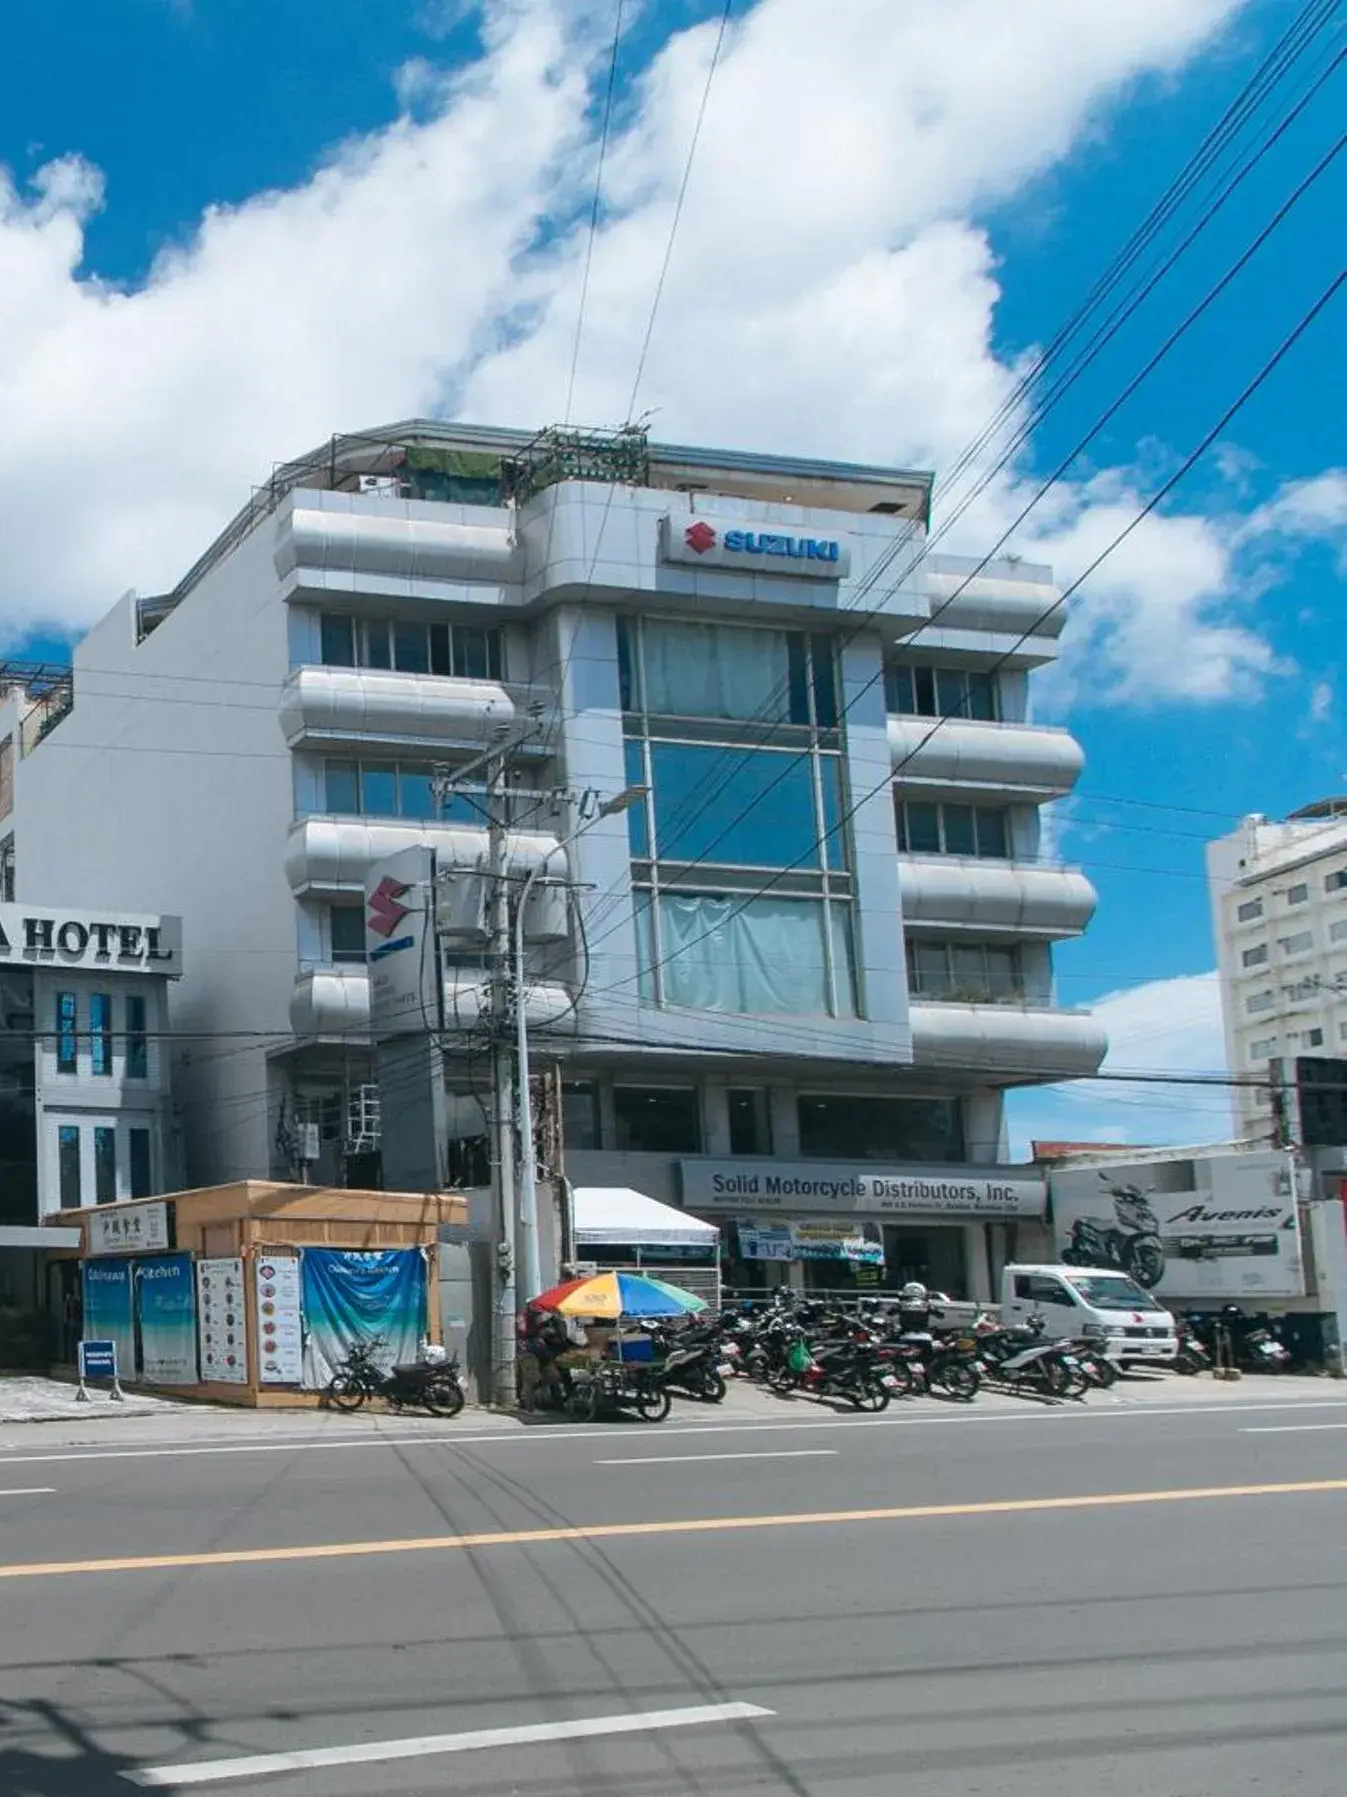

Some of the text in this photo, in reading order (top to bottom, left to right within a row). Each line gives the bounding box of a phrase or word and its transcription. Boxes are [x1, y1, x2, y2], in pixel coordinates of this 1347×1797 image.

[724, 530, 839, 562] SUZUKI
[23, 918, 173, 961] HOTEL
[713, 1174, 1020, 1202] Solid Motorcycle Distributors, Inc.
[1166, 1205, 1283, 1224] Avenis
